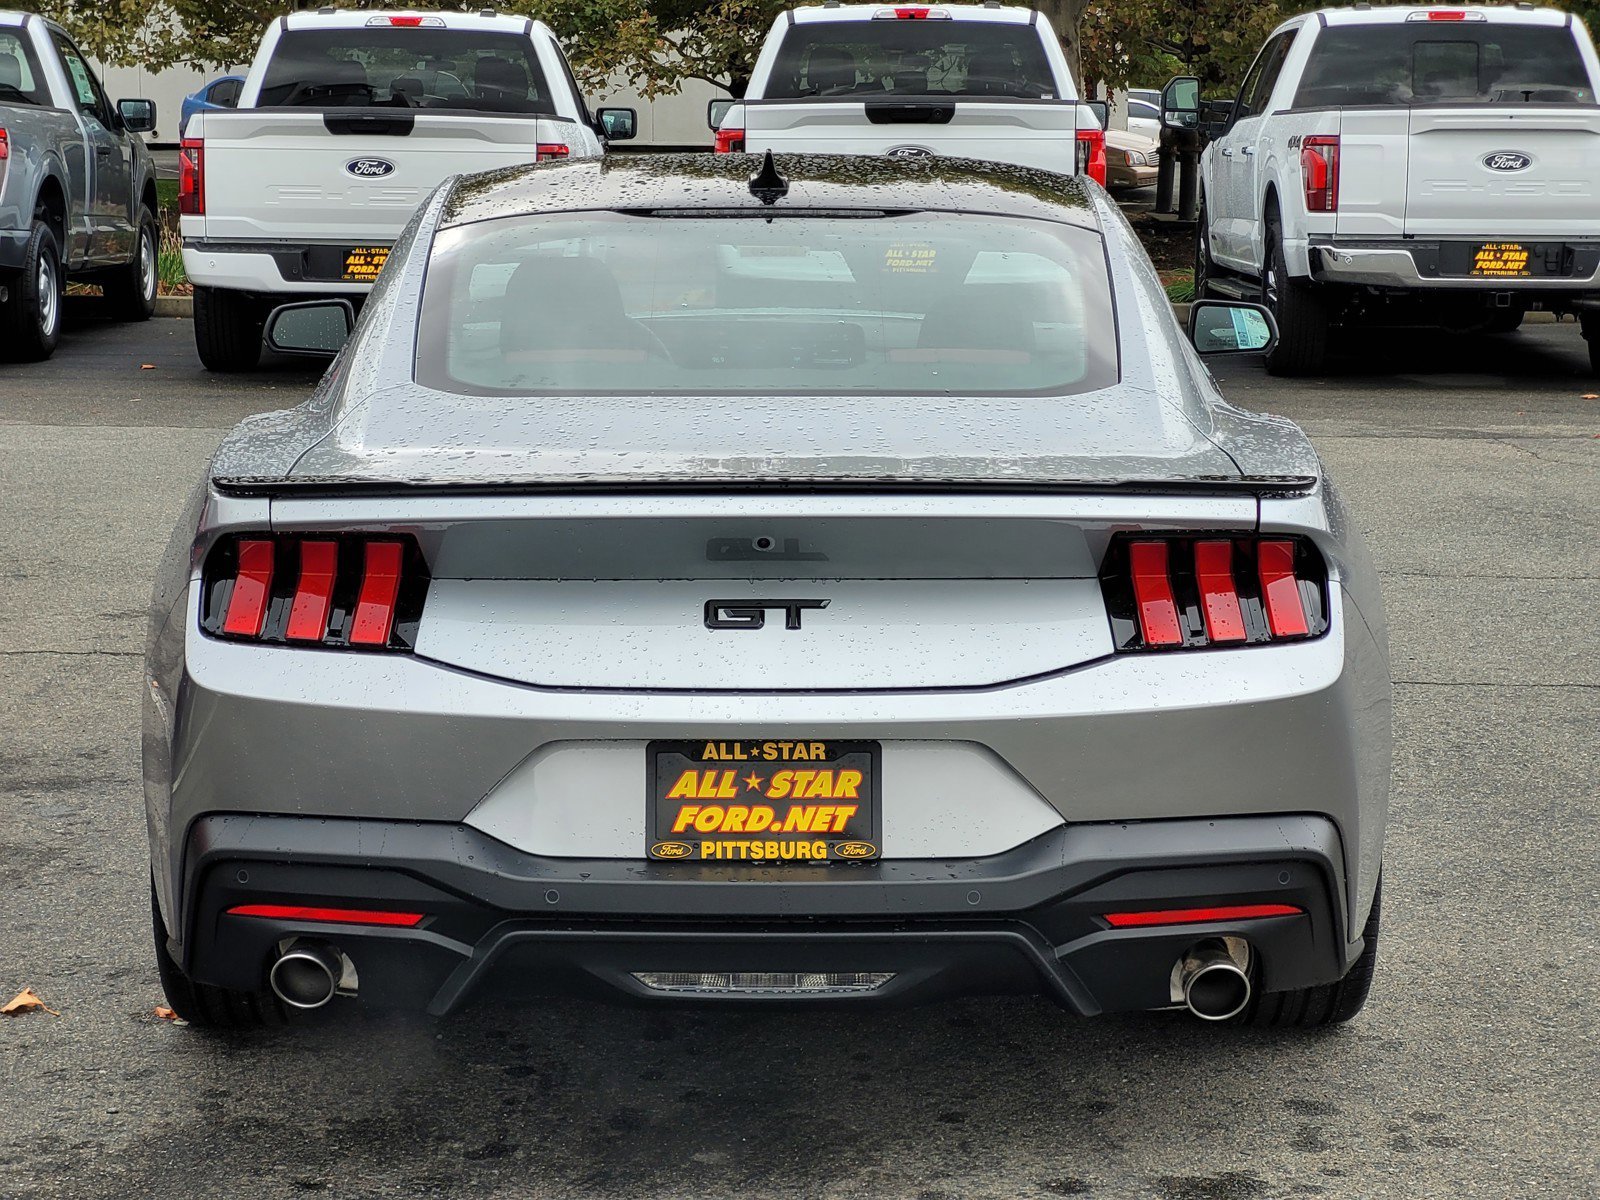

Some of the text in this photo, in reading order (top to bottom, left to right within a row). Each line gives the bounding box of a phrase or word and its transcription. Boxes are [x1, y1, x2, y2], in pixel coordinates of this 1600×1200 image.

[354, 160, 386, 175] Ford
[1491, 154, 1523, 169] Ford
[264, 184, 437, 207] F-15
[345, 255, 386, 264] ALL ST
[1474, 251, 1527, 260] ALL STAR
[1475, 261, 1525, 269] FORD.NET
[704, 598, 832, 630] GT
[702, 742, 826, 760] ALL STAR
[665, 769, 863, 799] ALL STAR
[671, 804, 859, 833] FORD.NET
[660, 841, 867, 860] Ford PITTSBURG Ford
